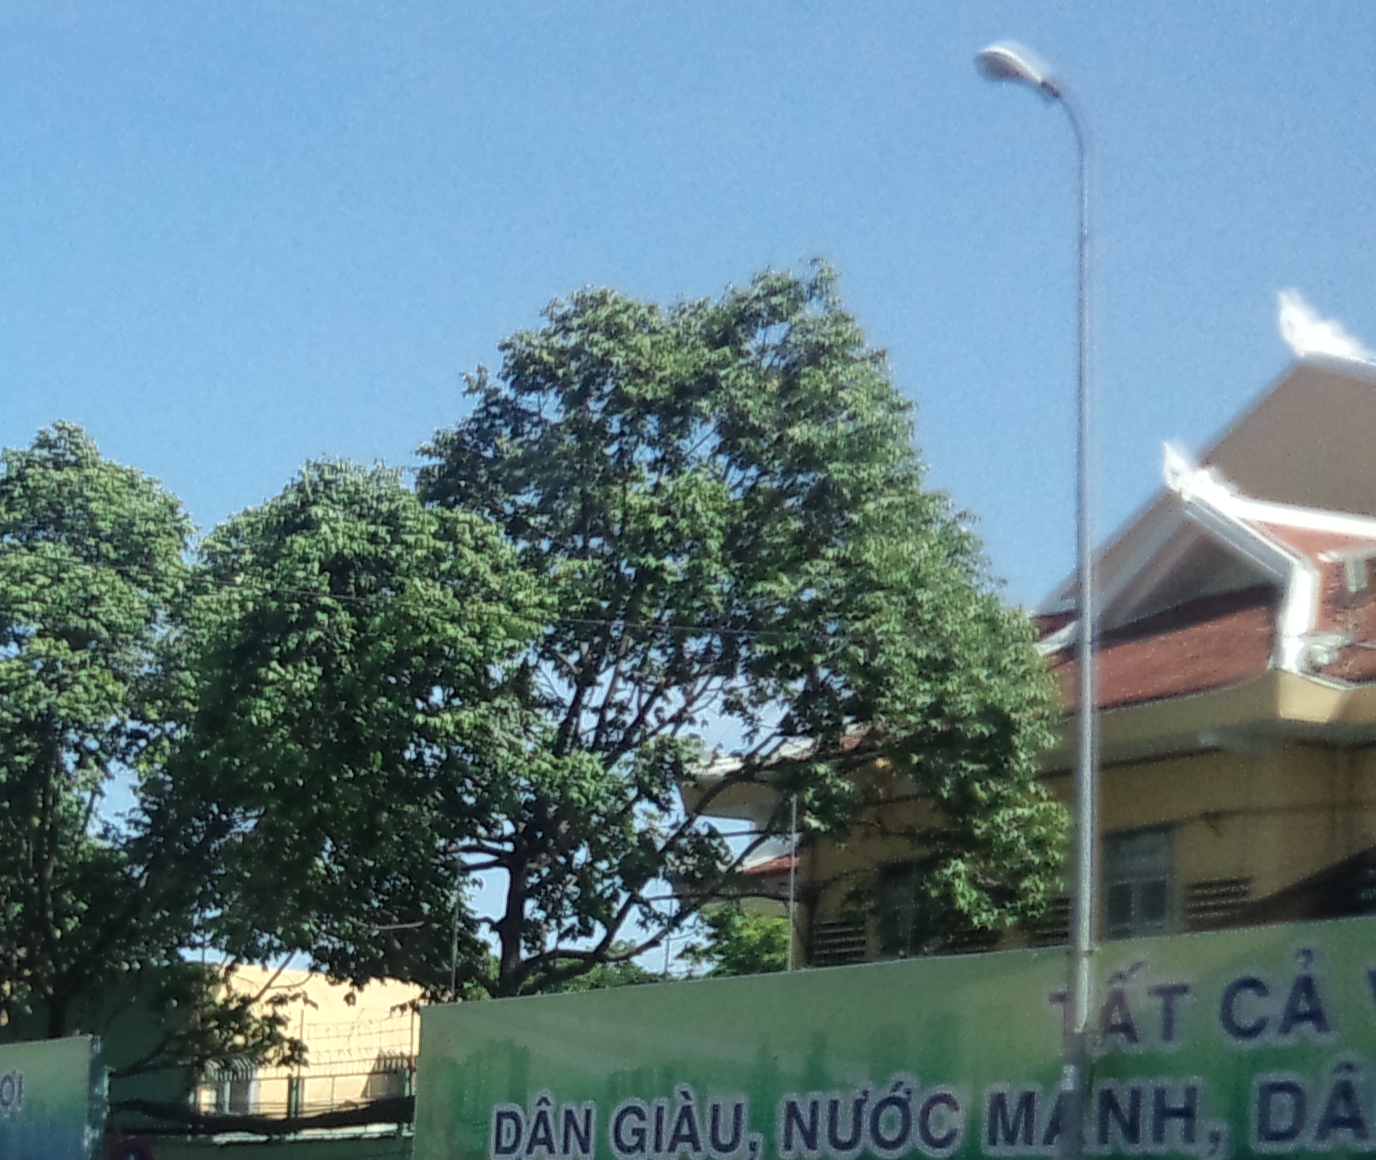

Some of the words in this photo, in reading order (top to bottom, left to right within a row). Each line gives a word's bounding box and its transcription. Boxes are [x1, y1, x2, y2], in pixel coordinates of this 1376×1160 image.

[1220, 949, 1331, 1038] CẢ
[493, 1096, 593, 1156] DÂN
[782, 1081, 962, 1152] NƯỚC
